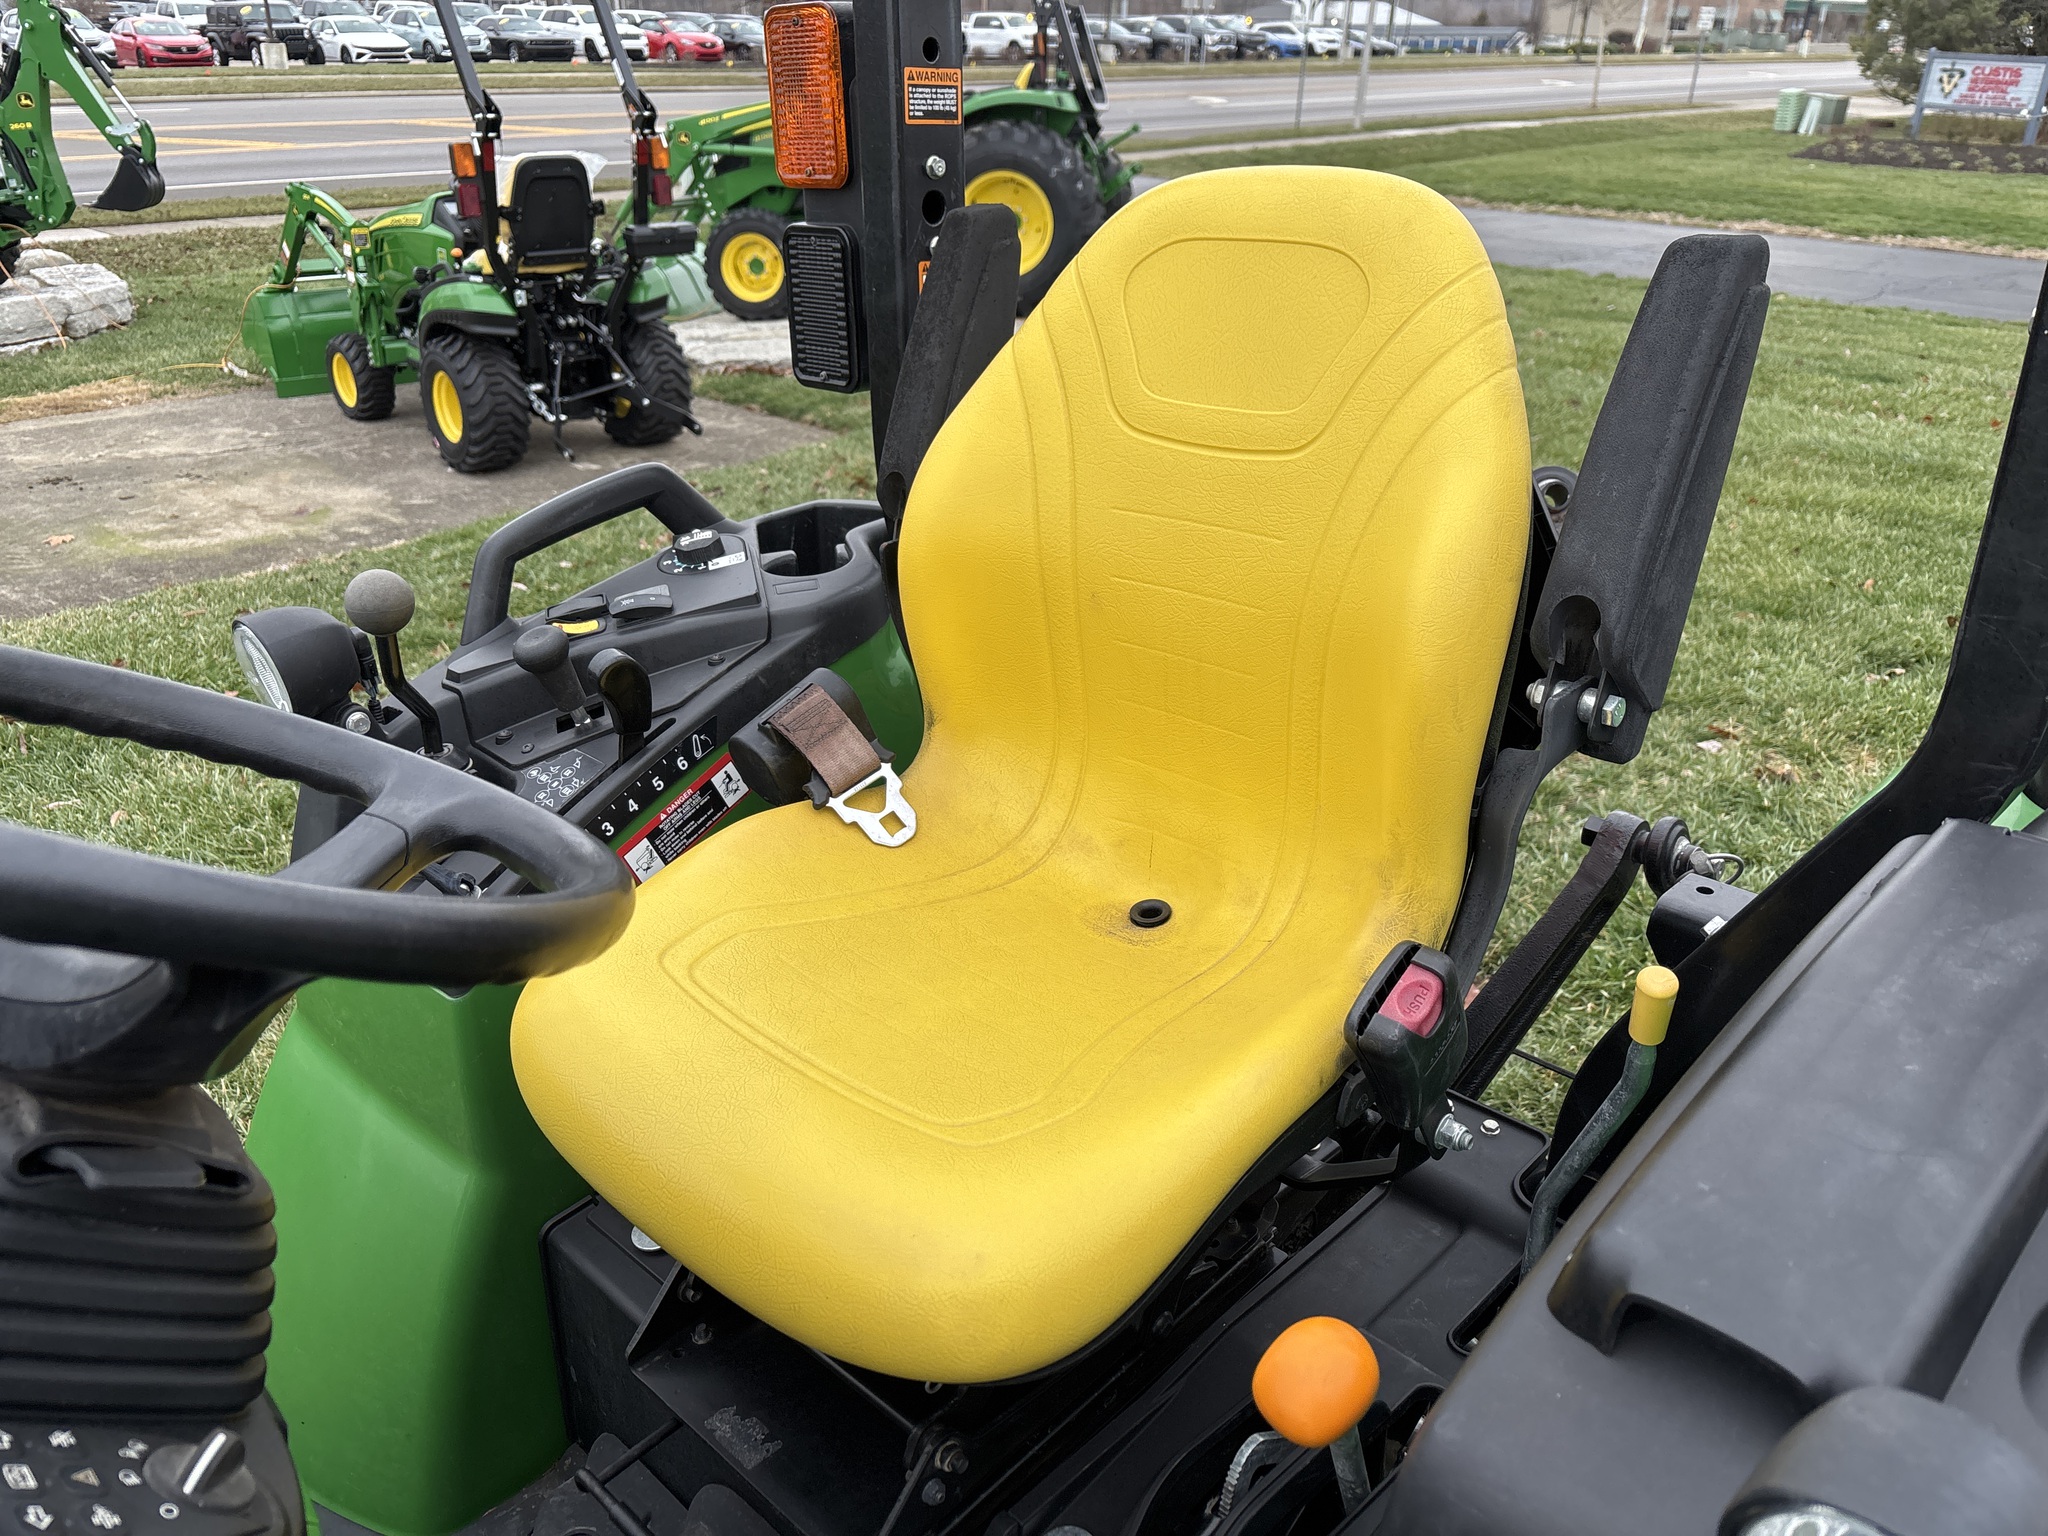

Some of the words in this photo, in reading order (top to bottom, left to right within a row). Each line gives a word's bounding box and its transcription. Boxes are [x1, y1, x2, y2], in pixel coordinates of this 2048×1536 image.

[915, 71, 958, 82] WARNING
[1971, 66, 2022, 78] CUSTIS
[676, 756, 688, 771] 6
[652, 776, 664, 791] 5
[628, 798, 639, 813] 4
[665, 787, 693, 814] DANGER
[658, 810, 678, 828] ROTATING
[676, 797, 692, 812] BLADES
[670, 812, 682, 823] ARMS
[689, 795, 701, 806] LEGS
[601, 822, 614, 836] 3
[1403, 984, 1430, 1014] PUSH
